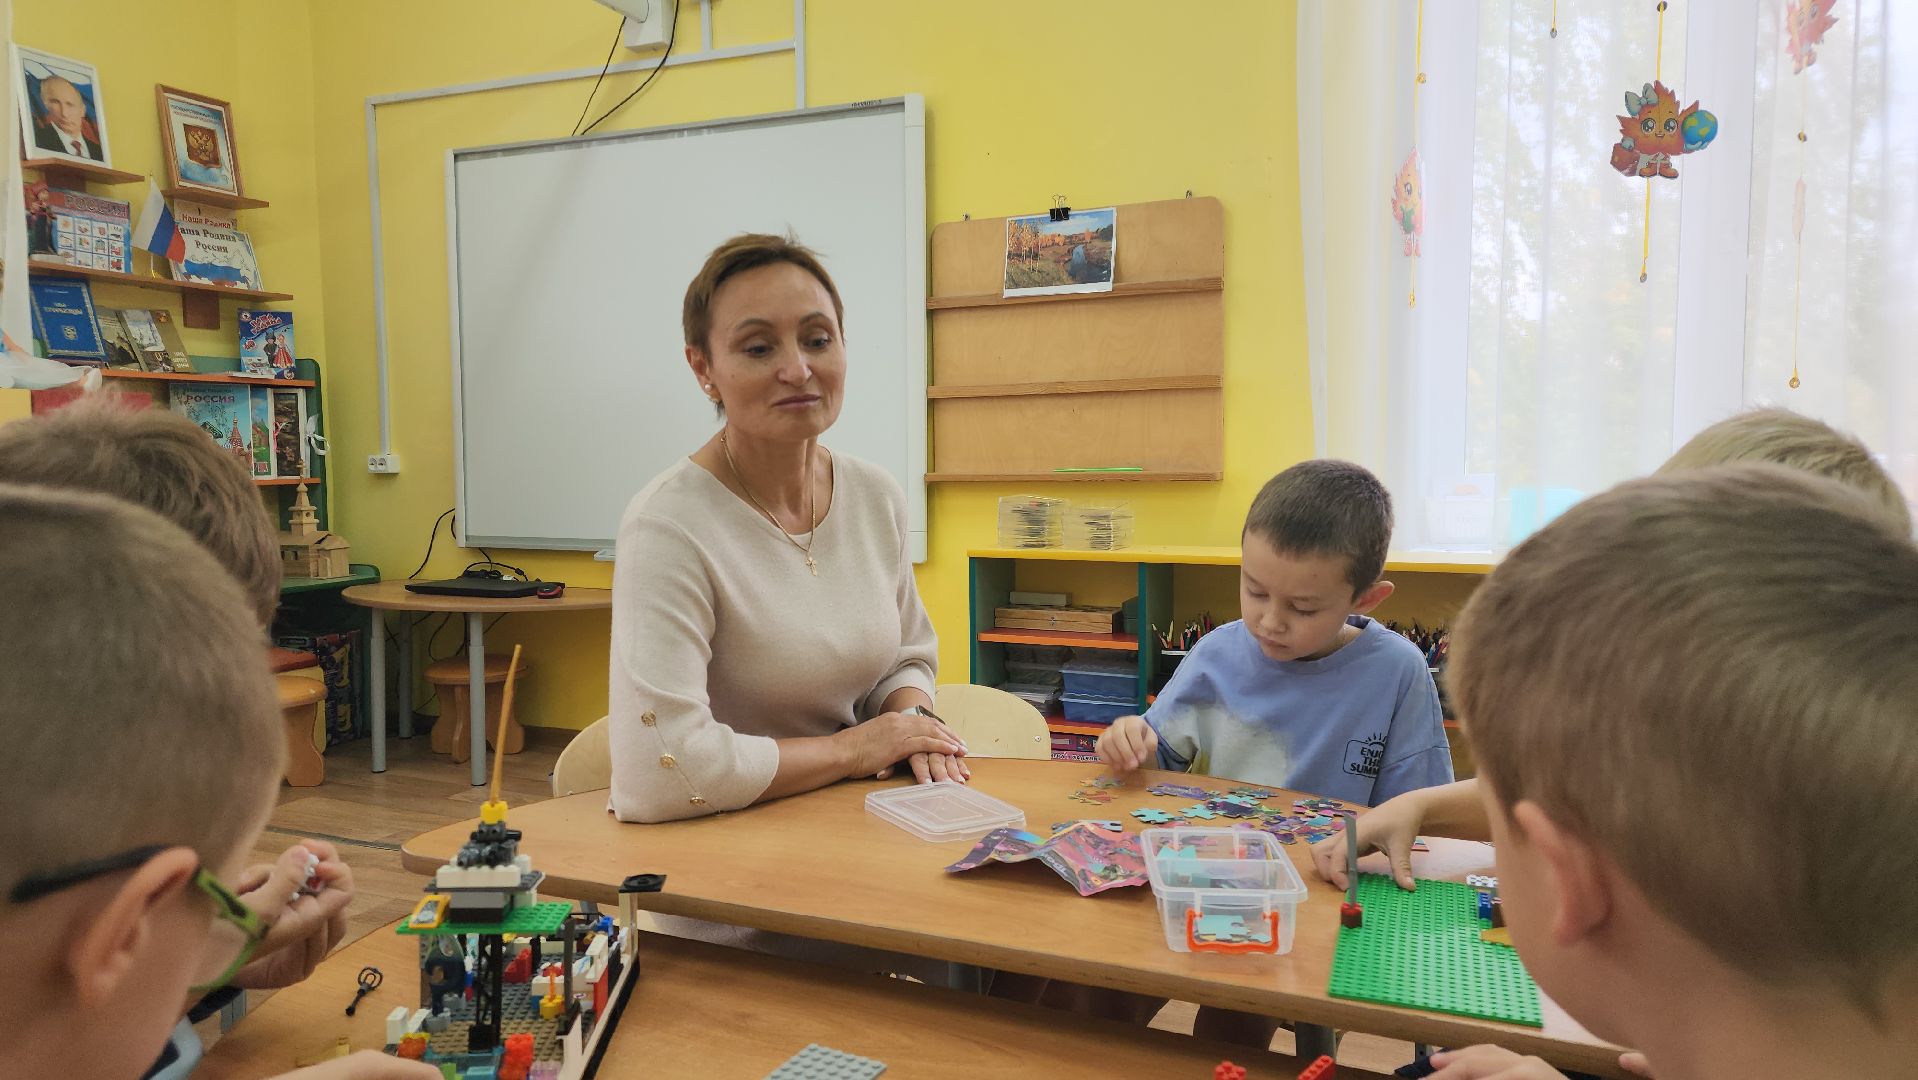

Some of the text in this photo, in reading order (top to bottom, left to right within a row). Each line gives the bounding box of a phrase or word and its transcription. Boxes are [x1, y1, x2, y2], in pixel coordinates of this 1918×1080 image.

[182, 213, 231, 229] Наша Родина
[179, 227, 237, 243] аша Родина
[194, 240, 229, 253] Россия
[186, 394, 235, 404] РОССИЯ
